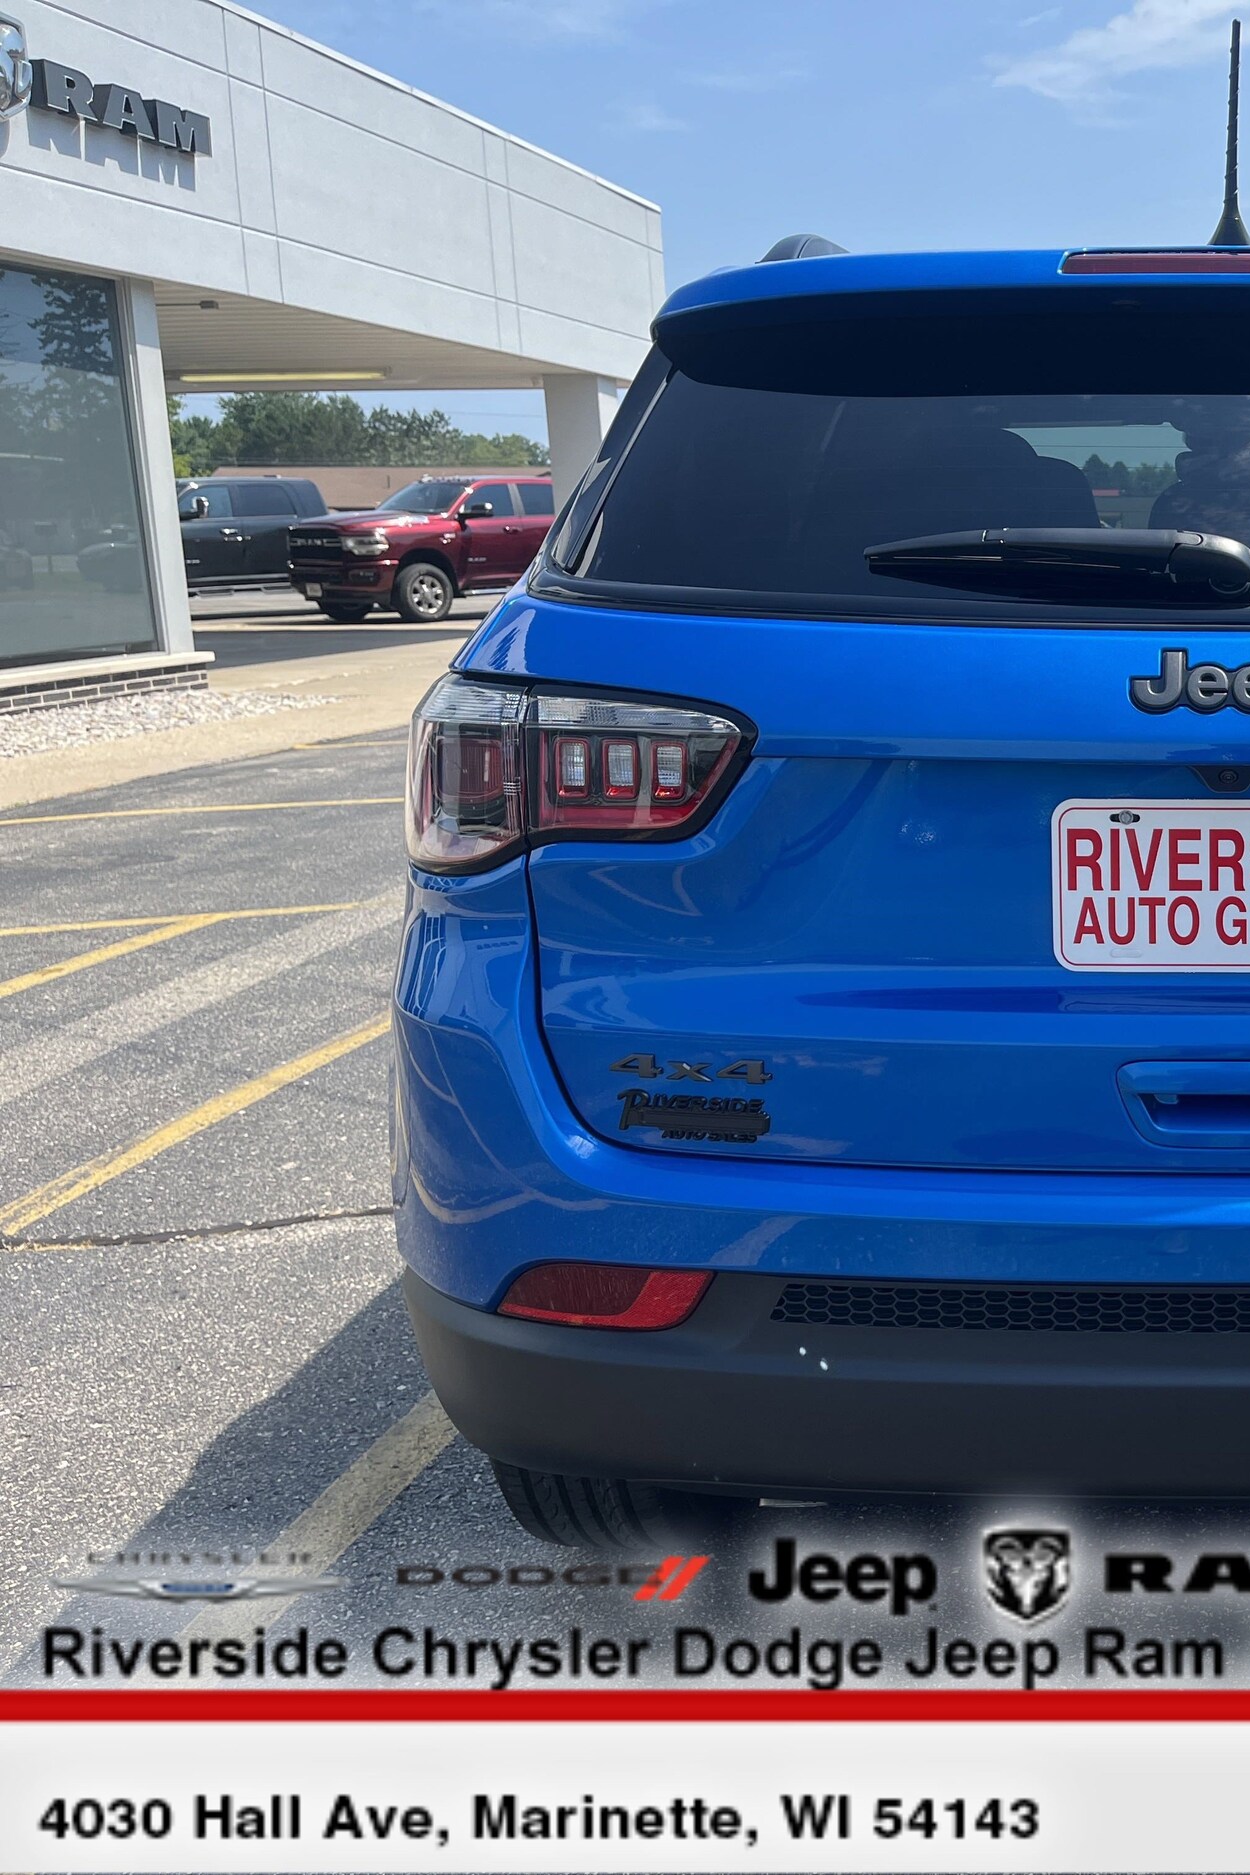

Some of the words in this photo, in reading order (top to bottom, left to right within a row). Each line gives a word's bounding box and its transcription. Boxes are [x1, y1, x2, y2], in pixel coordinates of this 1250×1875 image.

[29, 58, 213, 158] RAM
[1073, 896, 1200, 946] AUTO
[609, 1052, 773, 1085] 4x4
[661, 1128, 704, 1141] AUTO
